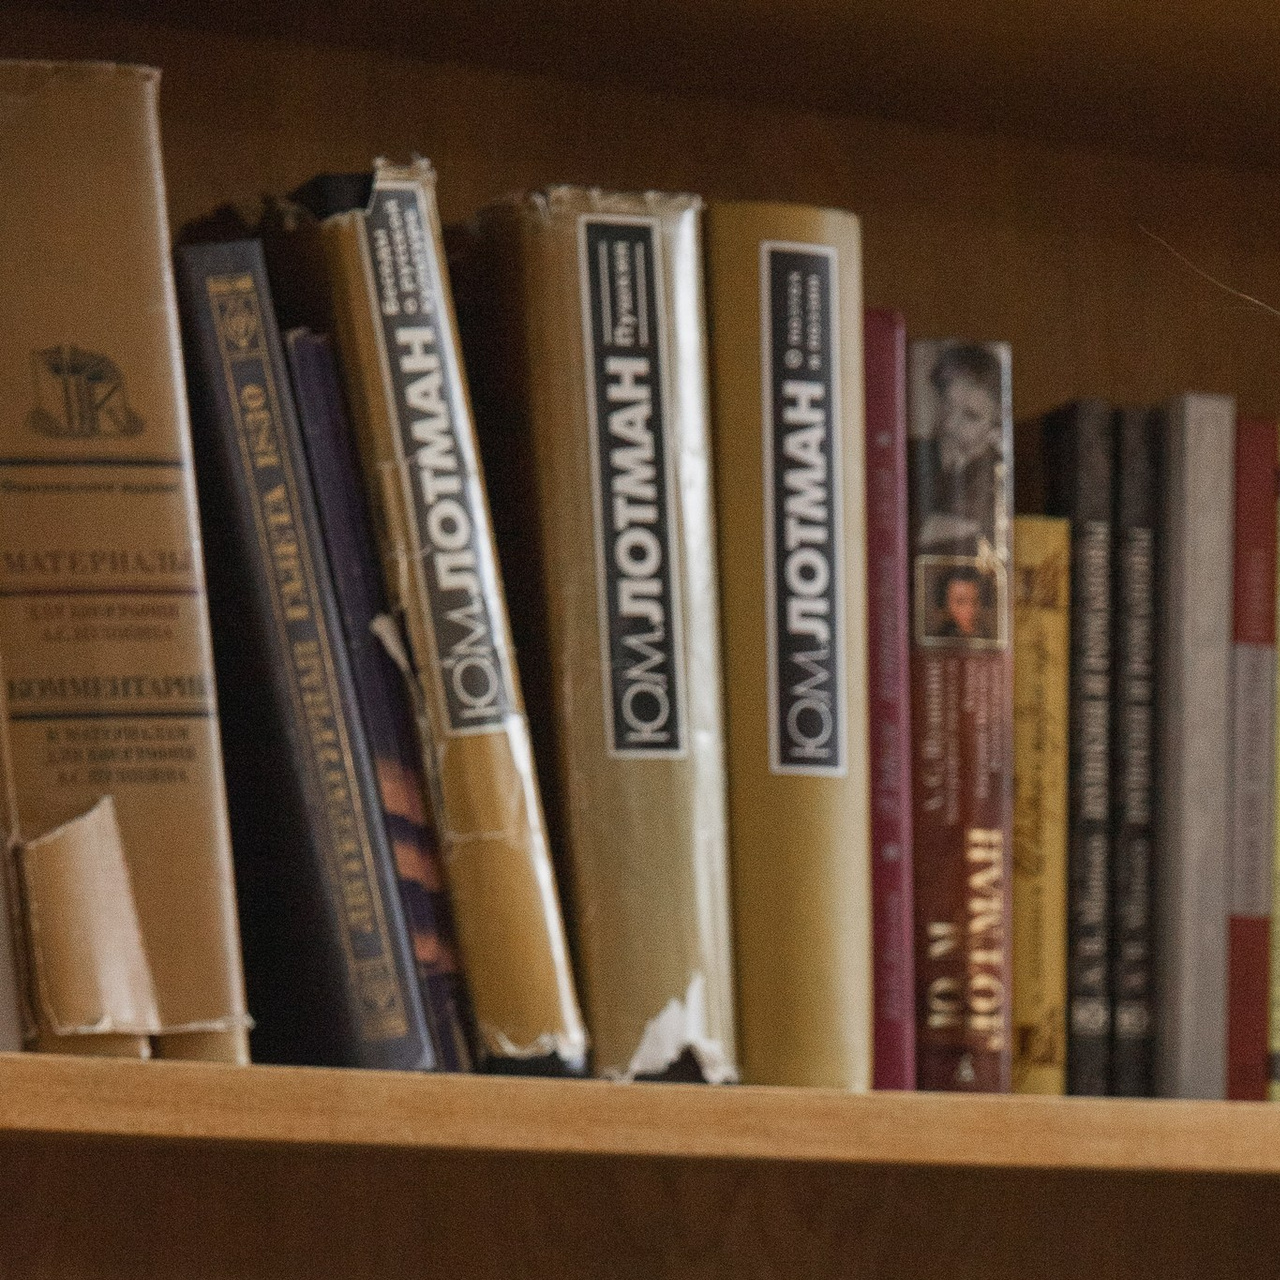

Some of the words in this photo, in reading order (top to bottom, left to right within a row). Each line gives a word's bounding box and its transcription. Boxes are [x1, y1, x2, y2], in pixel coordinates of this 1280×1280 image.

[611, 240, 637, 347] Пушкин
[237, 383, 281, 469] 1830
[260, 483, 312, 622] ГАЗЕТА
